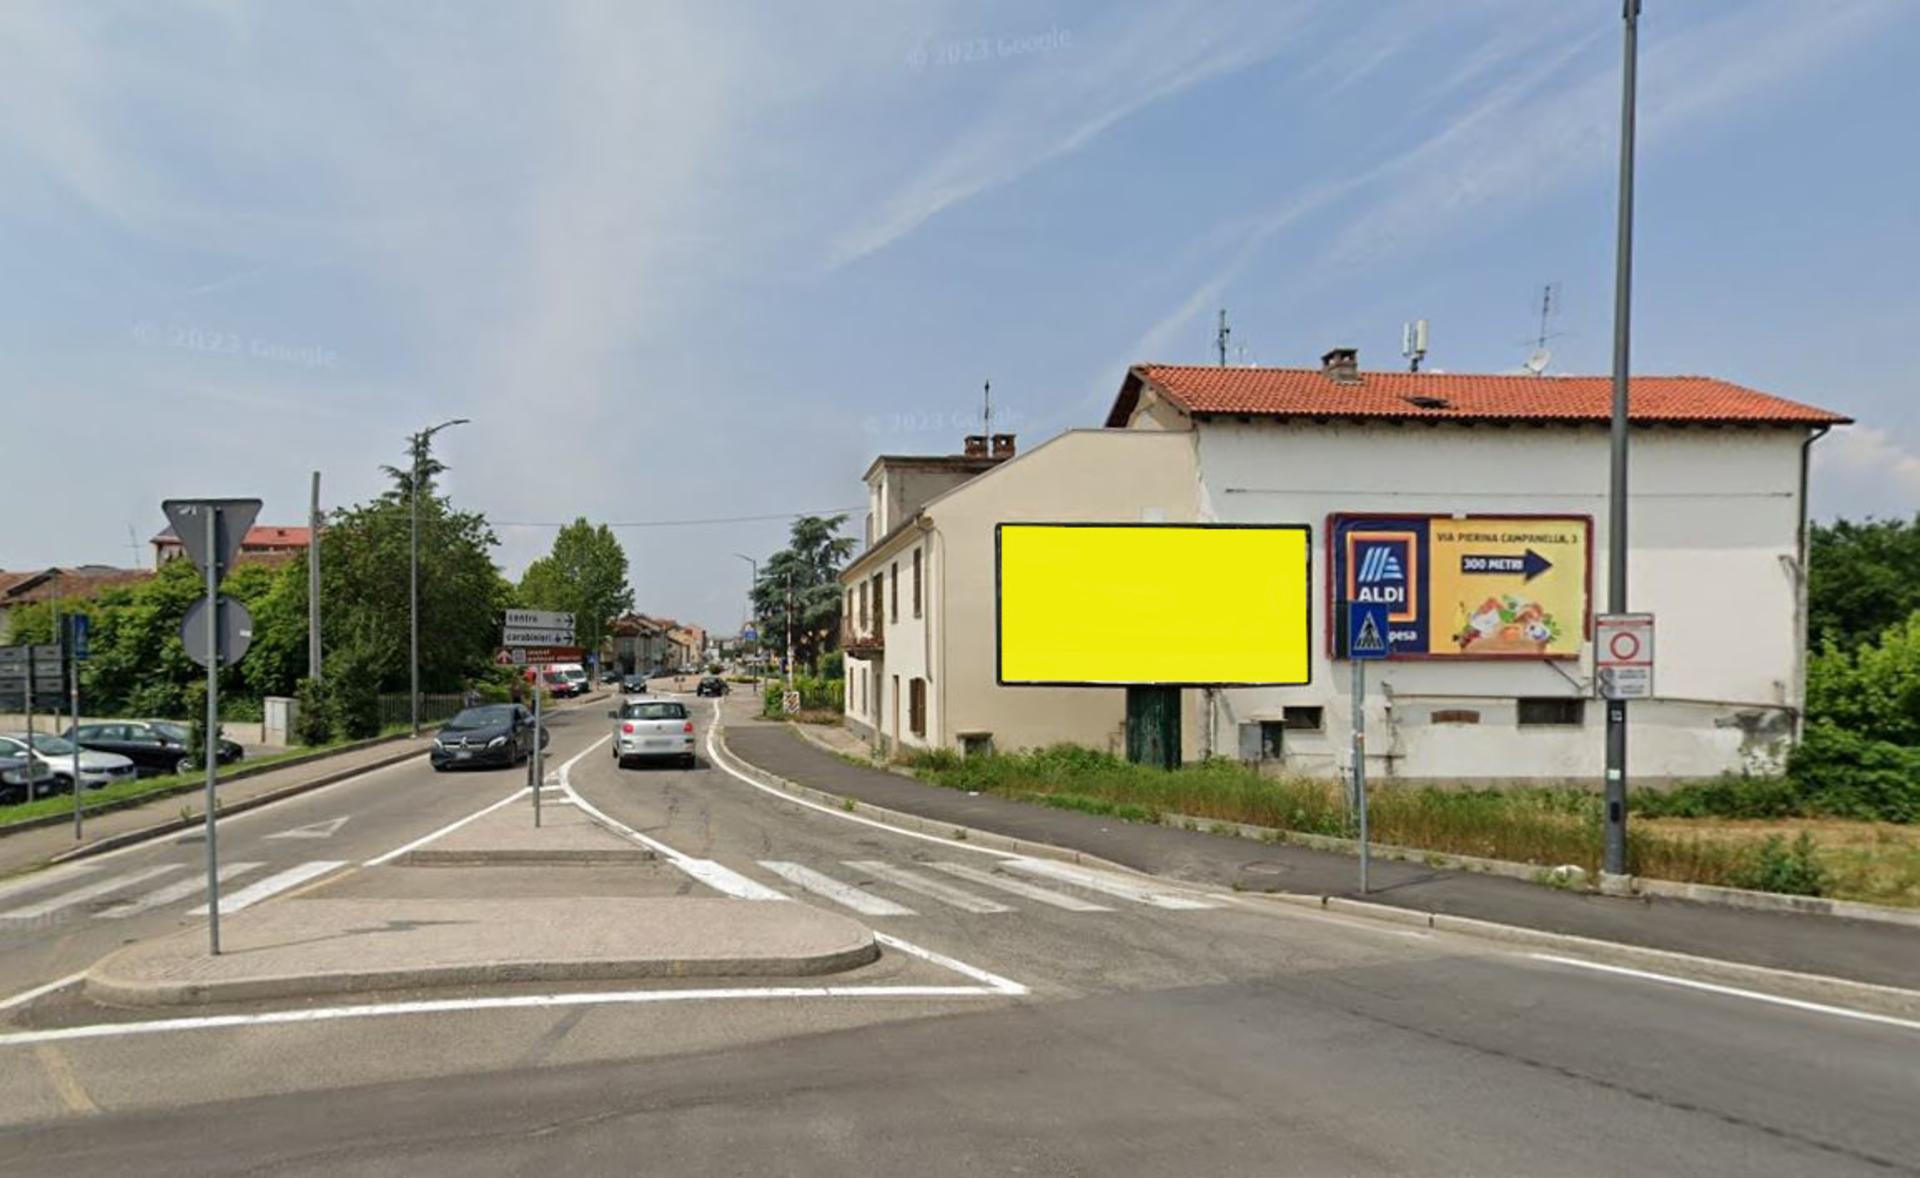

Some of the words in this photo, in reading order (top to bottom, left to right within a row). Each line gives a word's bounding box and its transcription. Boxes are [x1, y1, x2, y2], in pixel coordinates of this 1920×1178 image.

[1437, 532, 1454, 542] VIA
[1458, 532, 1498, 543] PIERINA
[1501, 533, 1569, 544] CAMPANELLA,
[1463, 558, 1486, 570] 300
[1488, 558, 1524, 570] METRI
[1357, 586, 1405, 602] ALDI
[508, 614, 537, 624] centro
[1388, 630, 1418, 643] pesa
